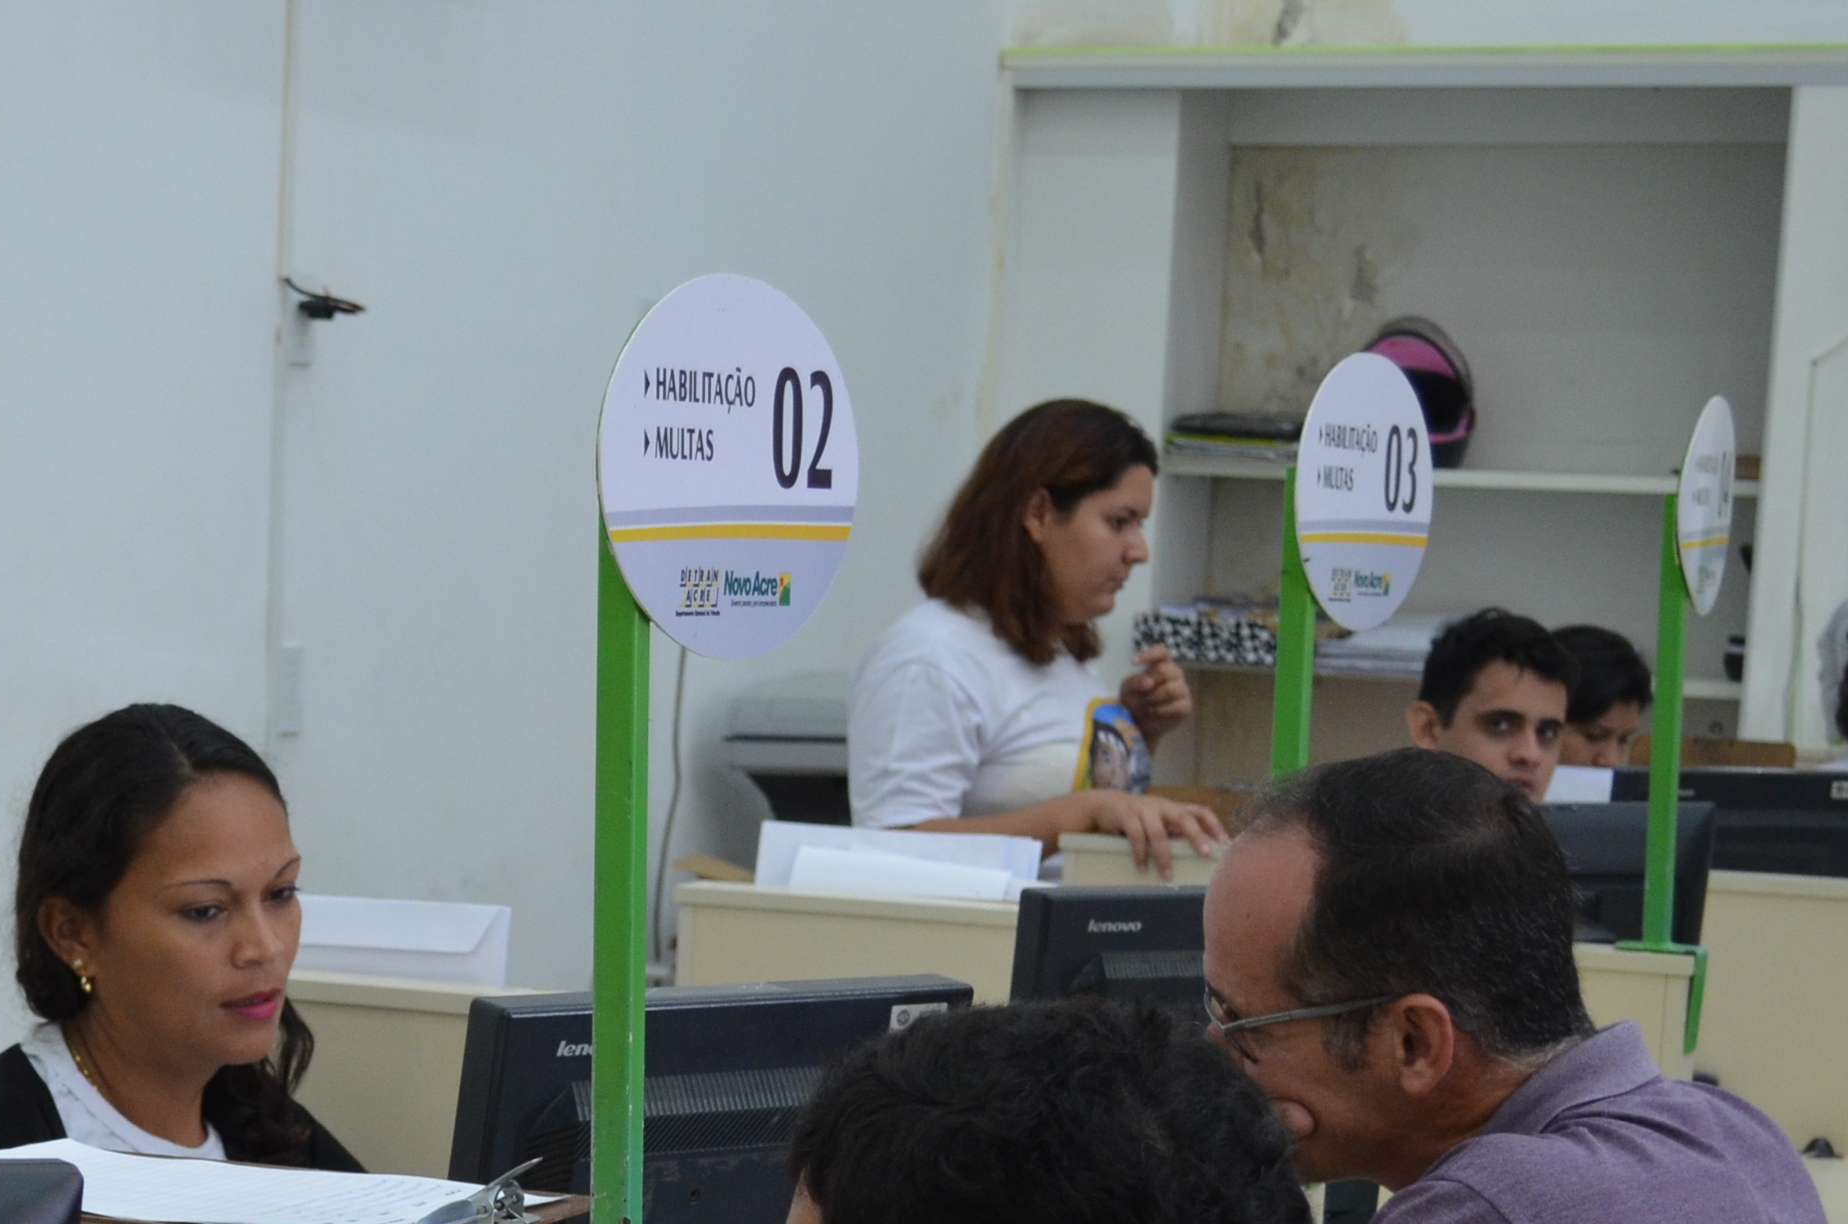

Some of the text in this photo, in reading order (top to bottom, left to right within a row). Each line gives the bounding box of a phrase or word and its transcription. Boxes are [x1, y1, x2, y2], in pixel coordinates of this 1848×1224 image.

[655, 366, 756, 415] HABILITAÇÃO
[772, 366, 834, 490] 02
[1324, 423, 1378, 457] HABILITAÇÃO
[654, 426, 714, 462] MULTAS
[1322, 465, 1354, 492] MULTAS
[1384, 424, 1418, 514] 03
[680, 569, 720, 582] DETRAN
[723, 570, 777, 596] Novo Acre
[686, 589, 711, 602] ACRE
[1088, 919, 1142, 933] lenovo
